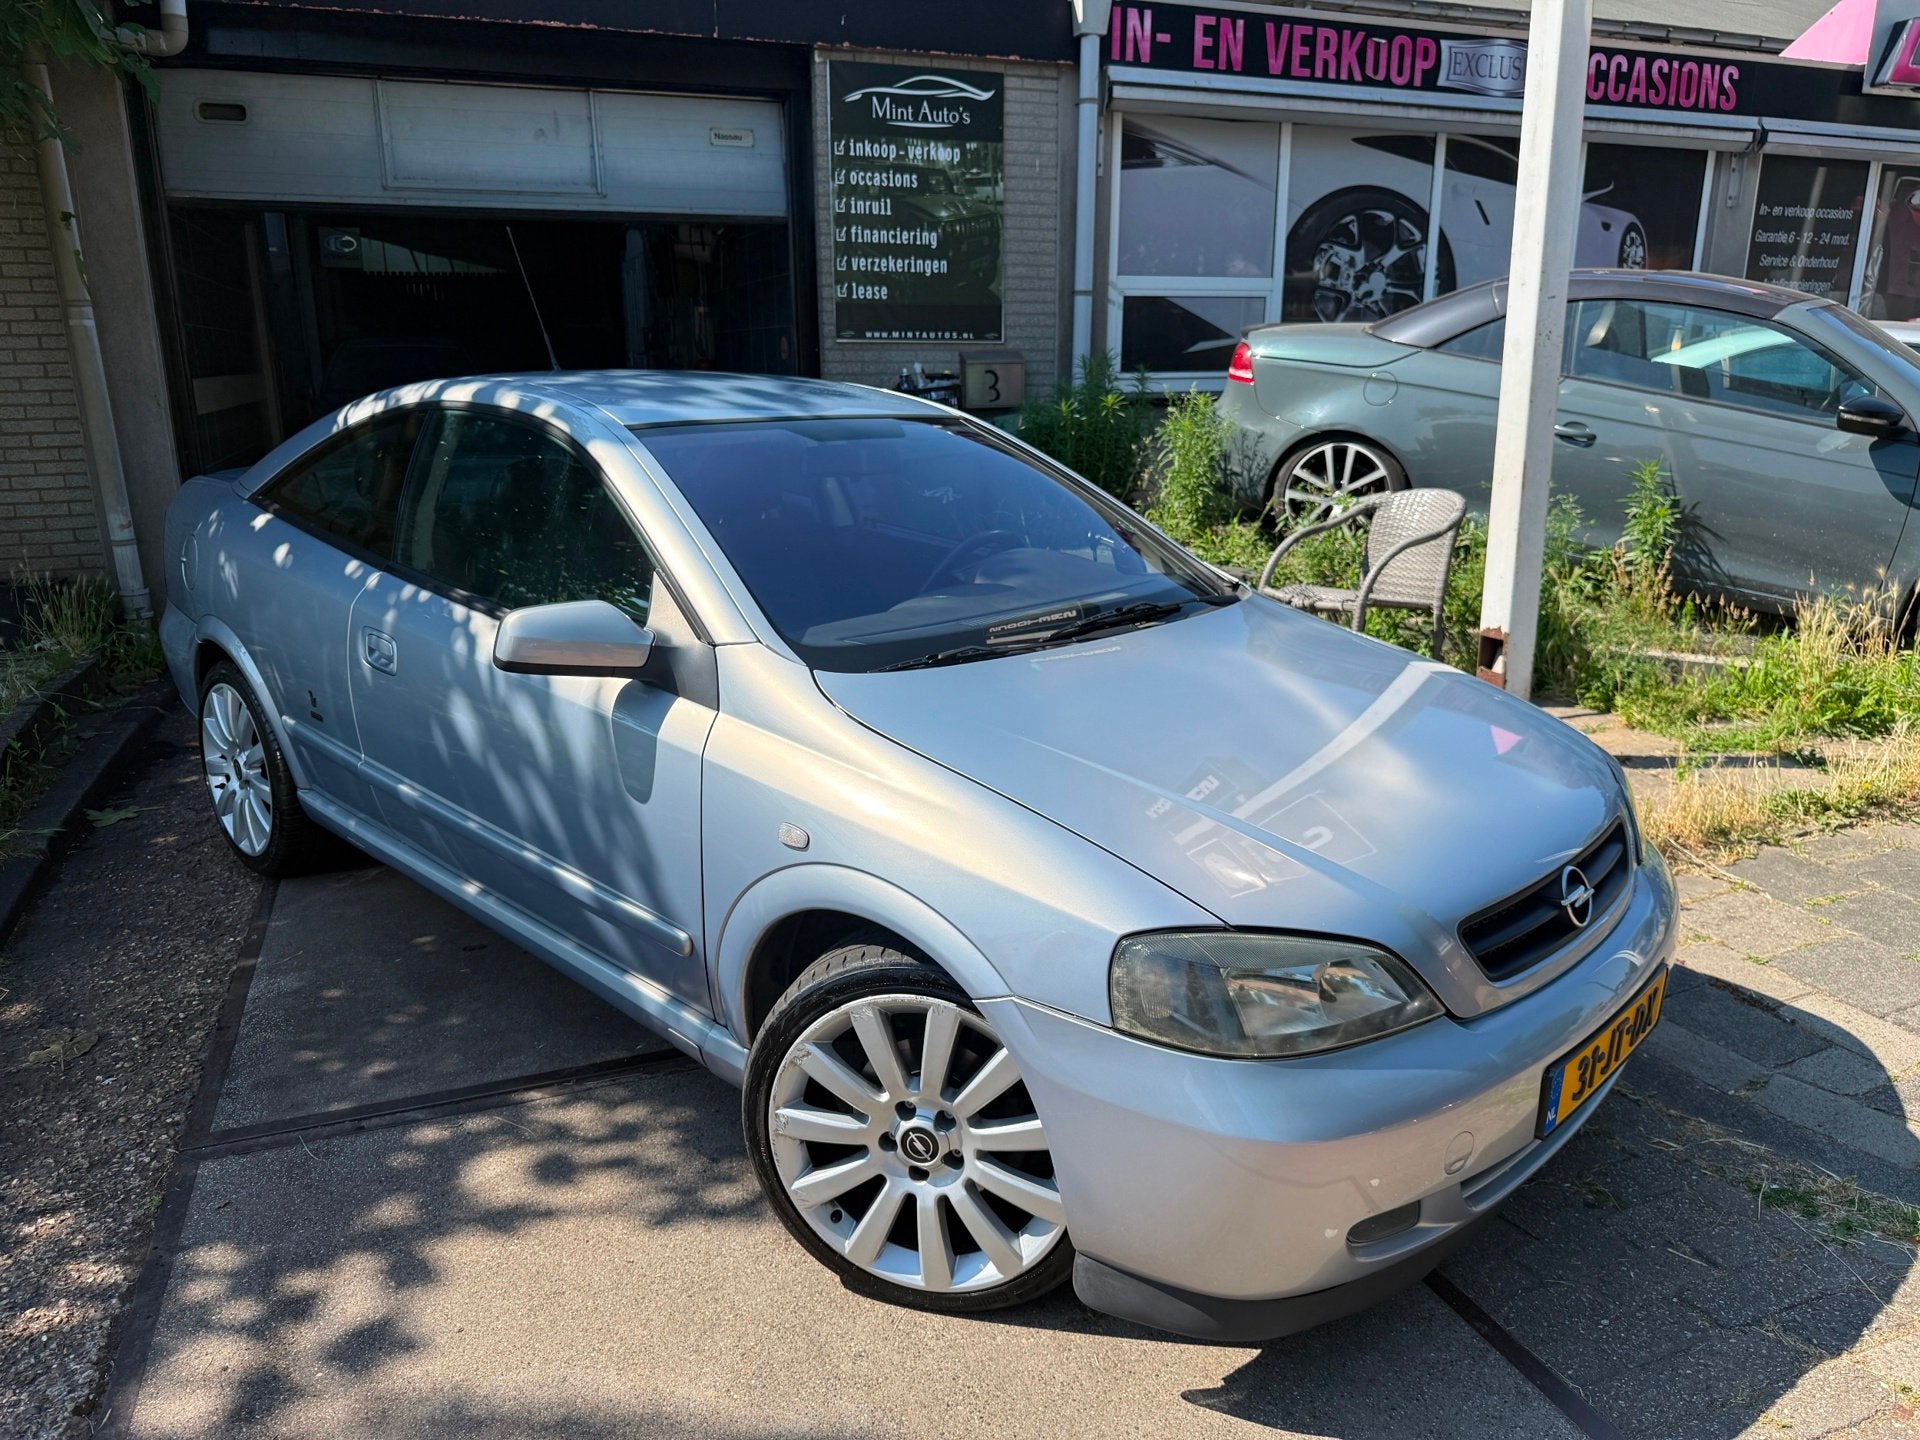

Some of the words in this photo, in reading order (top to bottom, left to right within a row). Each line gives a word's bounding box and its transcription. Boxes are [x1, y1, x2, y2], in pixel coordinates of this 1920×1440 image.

[1111, 6, 1172, 64] IN-
[1193, 14, 1245, 72] EN
[1265, 22, 1437, 87] VERKOOP
[1452, 51, 1525, 81] EXCLUS
[1586, 52, 1740, 112] CCASIONS
[872, 96, 913, 120] Mint
[918, 100, 971, 124] Auto's
[850, 169, 918, 188] occasions
[850, 198, 892, 216] inruil
[1772, 206, 1782, 217] en
[1784, 205, 1815, 220] verkoop
[1815, 207, 1854, 220] occasions
[851, 227, 938, 249] financiering
[1755, 229, 1788, 243] Garantie
[1788, 231, 1796, 244] 6
[1802, 231, 1814, 244] 12
[1819, 232, 1831, 245] 24
[851, 256, 948, 276] verzekeringen
[1759, 254, 1789, 267] Service
[1789, 255, 1796, 268] &
[1797, 255, 1840, 268] Onderhoud
[851, 283, 888, 299] lease
[985, 370, 1000, 402] 3
